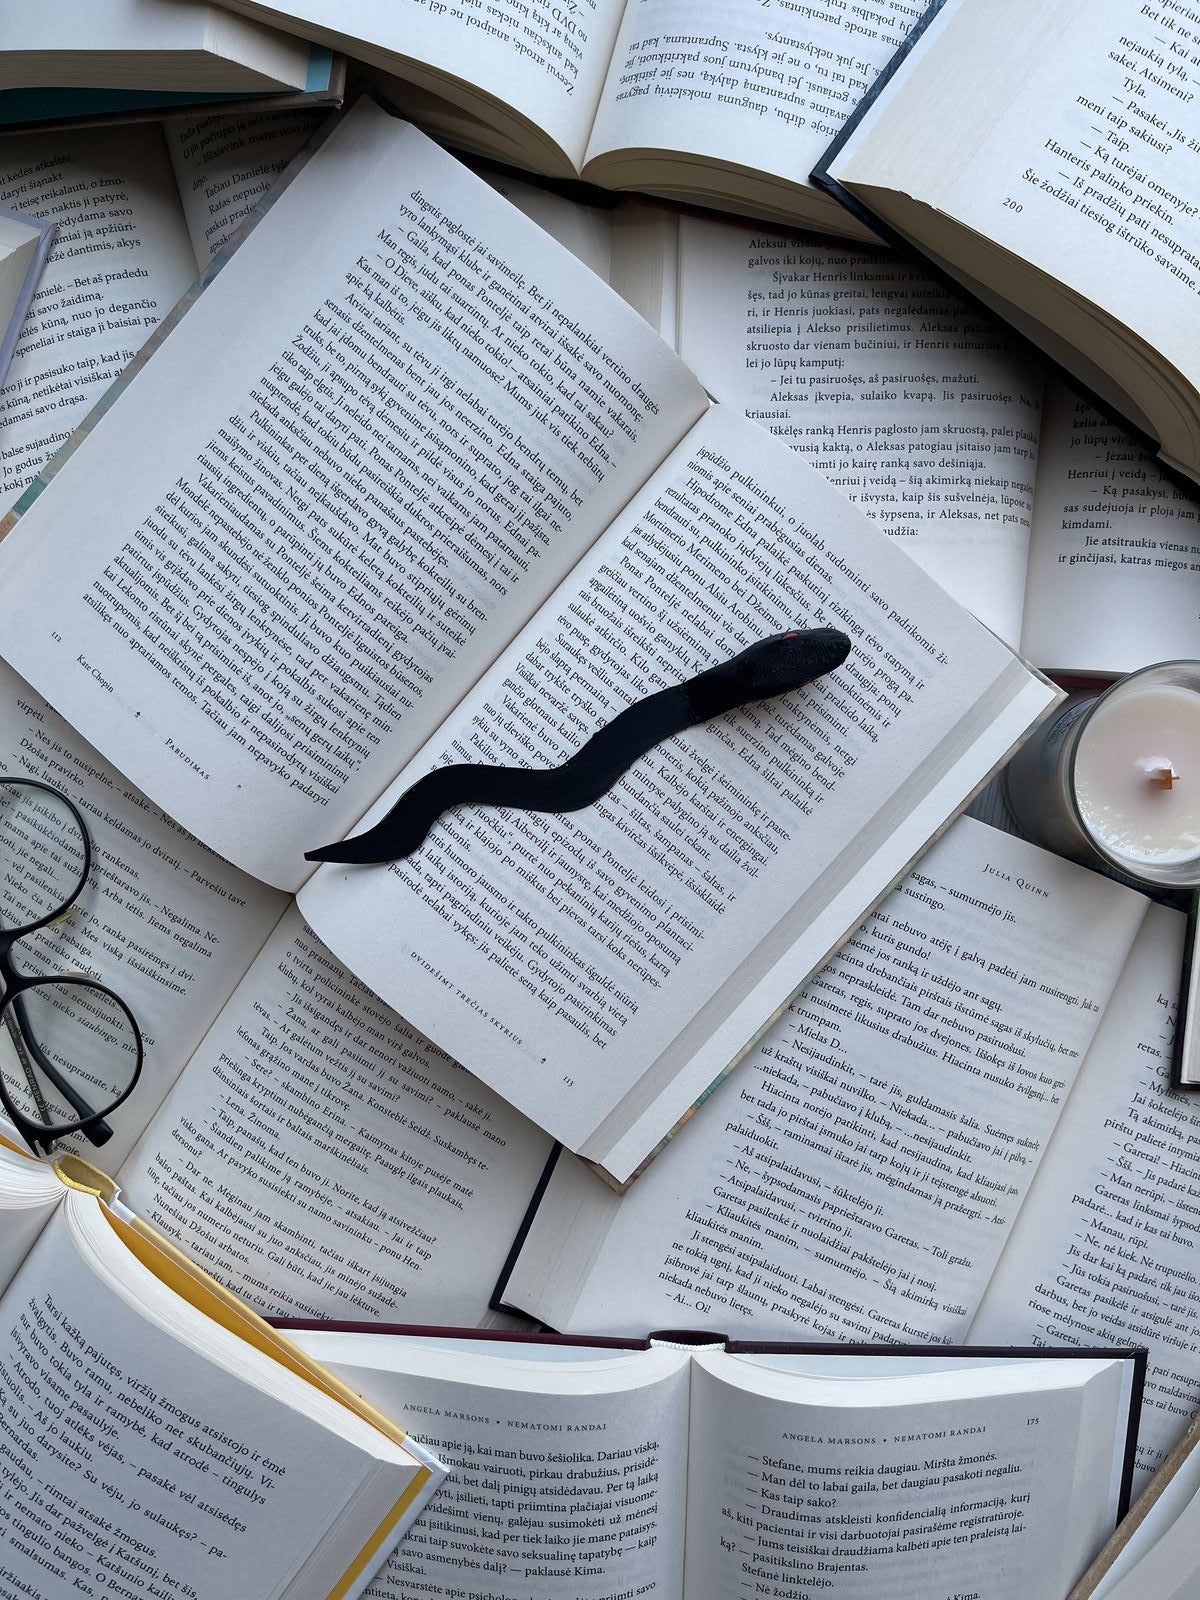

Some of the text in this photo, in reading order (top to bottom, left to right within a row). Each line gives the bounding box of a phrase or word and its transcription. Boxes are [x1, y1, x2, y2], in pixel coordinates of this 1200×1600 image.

[449, 8, 574, 96] Zeevui atrodė, anaiptol ne
[764, 31, 871, 76] Jie juk neklystantys.
[637, 51, 850, 102] geriausi. Jei bandytum juos pakritikuoti,
[1107, 51, 1194, 103] sakei. Atsimeni?
[1122, 76, 1146, 98] Tyla.
[1075, 95, 1173, 155] meni taip sakiusi?
[1044, 137, 1173, 226] Hanteris palinko priekin.
[1002, 197, 1023, 213] 200
[36, 292, 104, 316] savo žaidimą.
[410, 190, 660, 415] dingstis paglostė jai savimeilę. Bet ji nepalankiai vertino draugės
[745, 357, 845, 371] lei jo lūpų kamputį:
[769, 389, 1015, 404] Aleksas įkvepia, sulaiko kvapą. Jis pasiruošęs.
[686, 460, 833, 585] niomis apie seniai prabėgusias dienas.
[1061, 518, 1112, 530] kimdami.
[196, 454, 408, 644] riausių ingredientų, o parūpinti jų buvo Ednos pareiga.
[76, 653, 114, 693] Kate Chopin
[19, 737, 84, 788] Džošas pravirko.
[101, 850, 140, 880] rankenas.
[101, 887, 212, 958] Arba tėtis. Jiems negalima
[870, 925, 932, 960] kuris gundo!
[388, 861, 607, 1049] pasirodė nelabai vykęs: jis palietė seną kaip pasaulis, bet
[277, 961, 430, 1069] klubų, kol vyrai kalbėjo man virš galvos.
[410, 951, 523, 1045] DVIDEŠIMT TREČIAS SKYRIUS
[212, 1064, 369, 1175] džinsiniais šortais ir baltais marškinėliais.
[724, 1122, 779, 1150] palaiduokit.
[171, 1128, 203, 1158] dersonu?
[153, 1192, 249, 1264] Nunešiau Džošui arbatos.
[684, 1208, 763, 1250] kliaukitės manim.
[1071, 1194, 1194, 1248] padarė... kad ir kas tai buvo.
[44, 1293, 286, 1476] Tarsi kažką pajutęs, viržių žmogus atsistojo ir ėmė
[402, 1403, 606, 1432] ANGELA MARSONS NEMATOMI RANDAI
[781, 1425, 986, 1445] ANGELA MARSONS NEMATOMI RANDAI
[1026, 1417, 1039, 1426] 175
[441, 1440, 660, 1463] apie ją, kai man buvo šešiolika. Dariau viską,
[721, 1507, 1024, 1541] aš, kiti pacientai ir visi darbuotojai pasirašėme registratūroje.
[741, 1562, 834, 1590] Stefanė linktelėjo.
